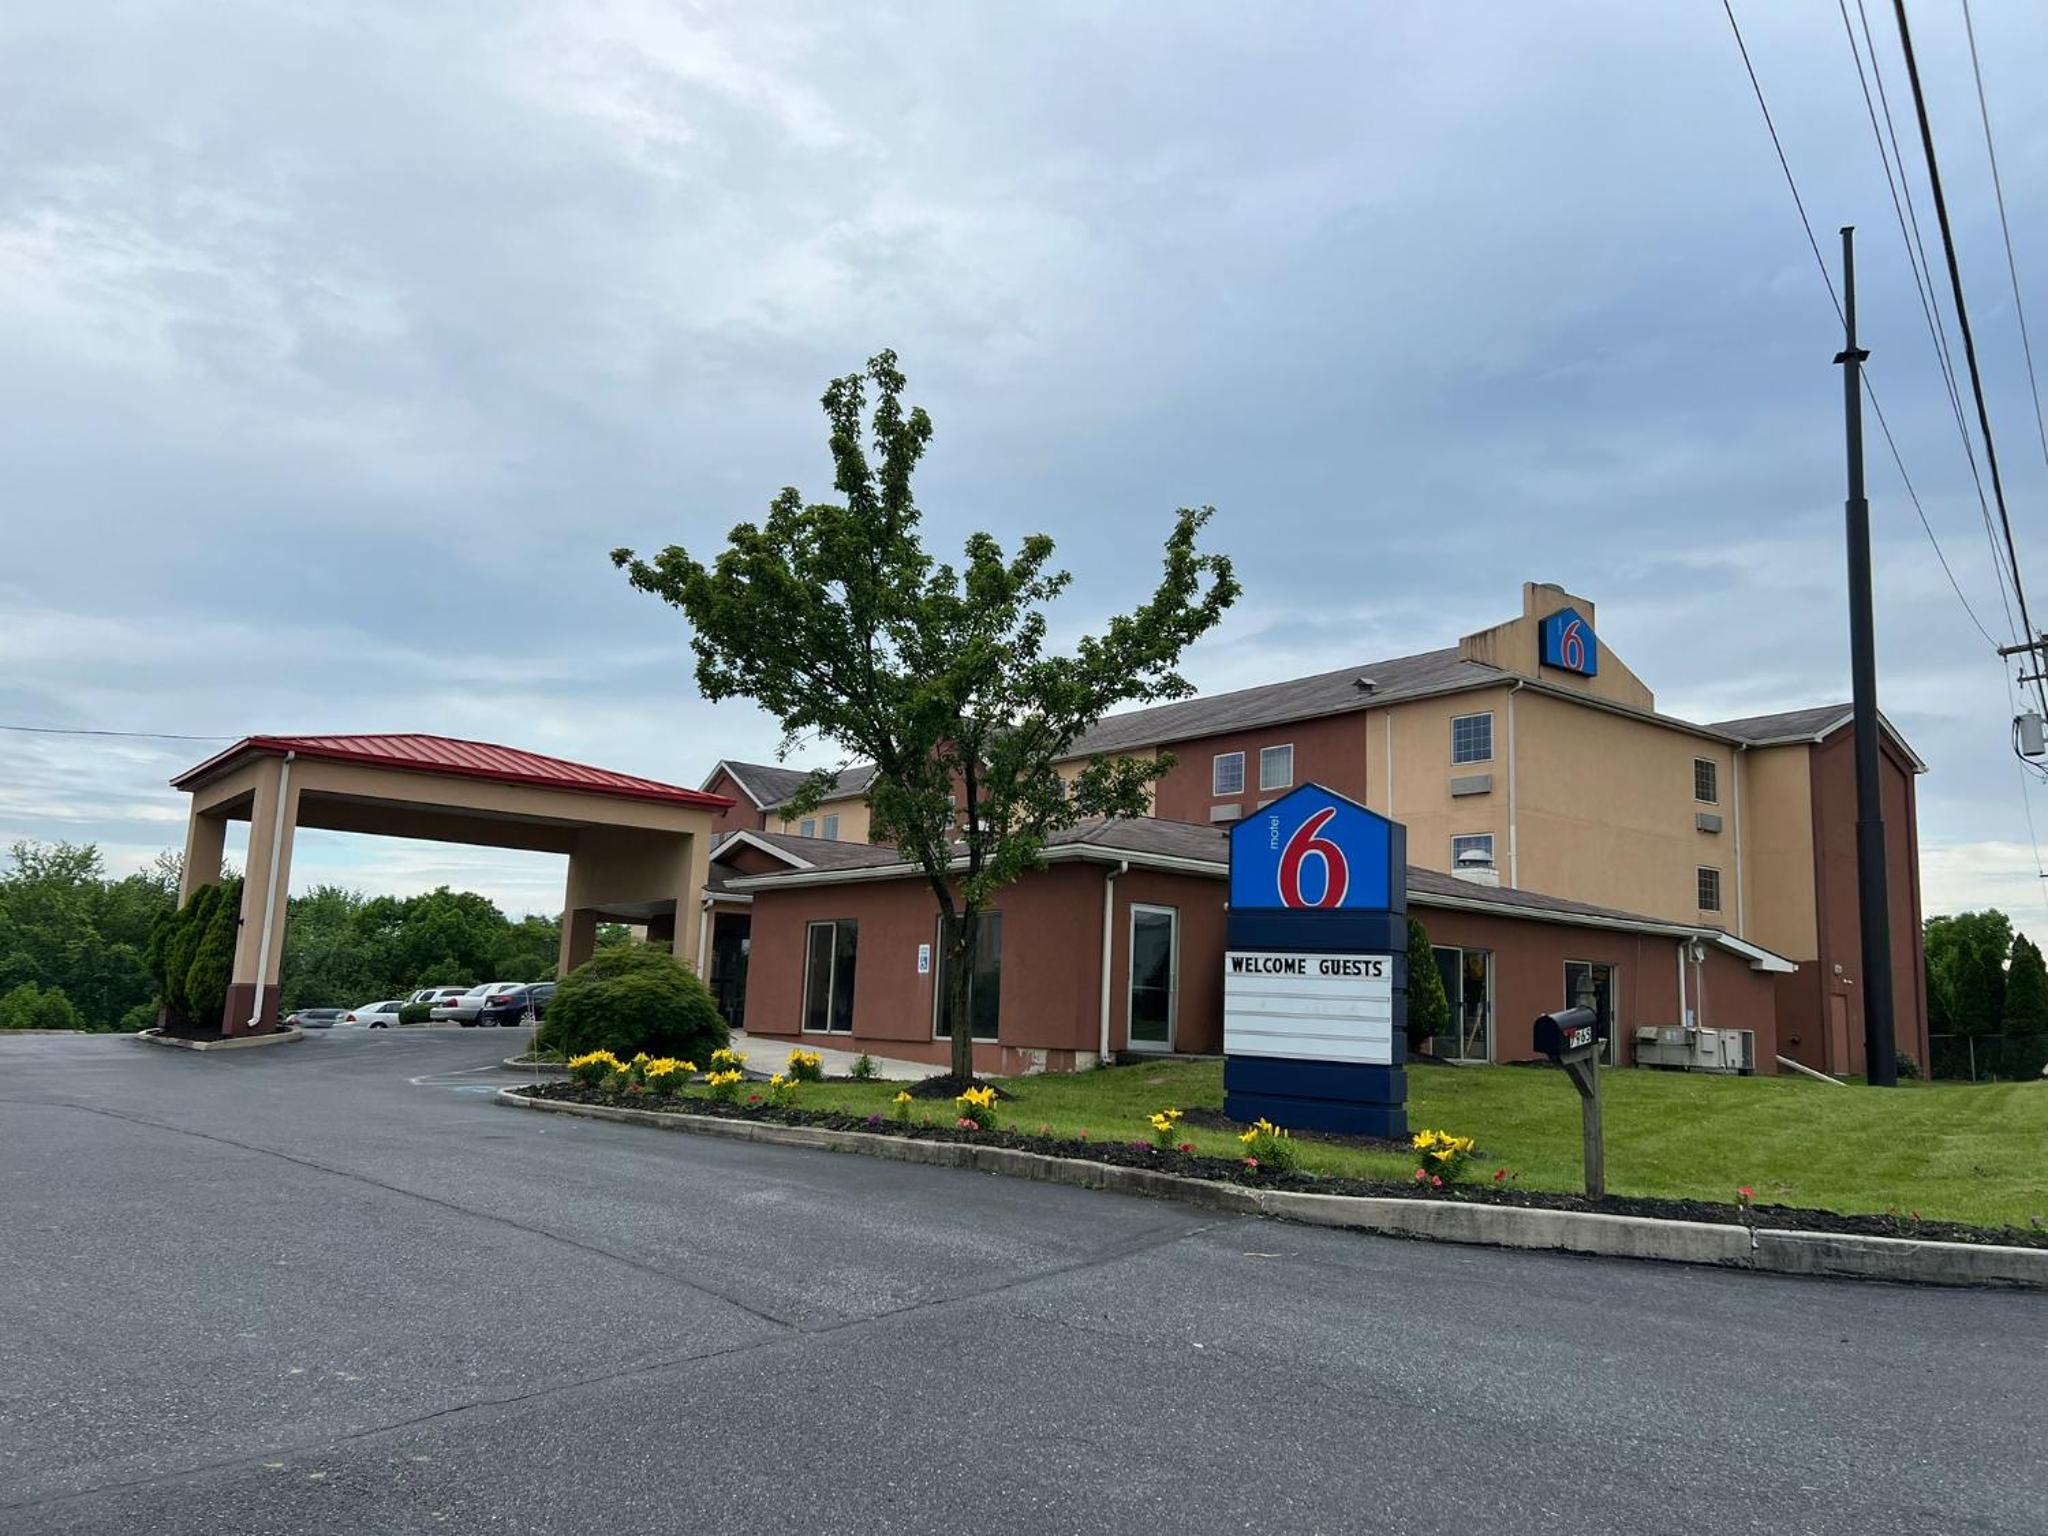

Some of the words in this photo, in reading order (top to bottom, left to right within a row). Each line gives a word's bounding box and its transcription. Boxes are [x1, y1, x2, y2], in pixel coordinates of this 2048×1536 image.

[1561, 619, 1584, 671] 6
[1269, 815, 1279, 849] motel
[1277, 806, 1349, 908] 6
[1231, 957, 1306, 974] WELCOME
[1319, 959, 1383, 977] GUESTS
